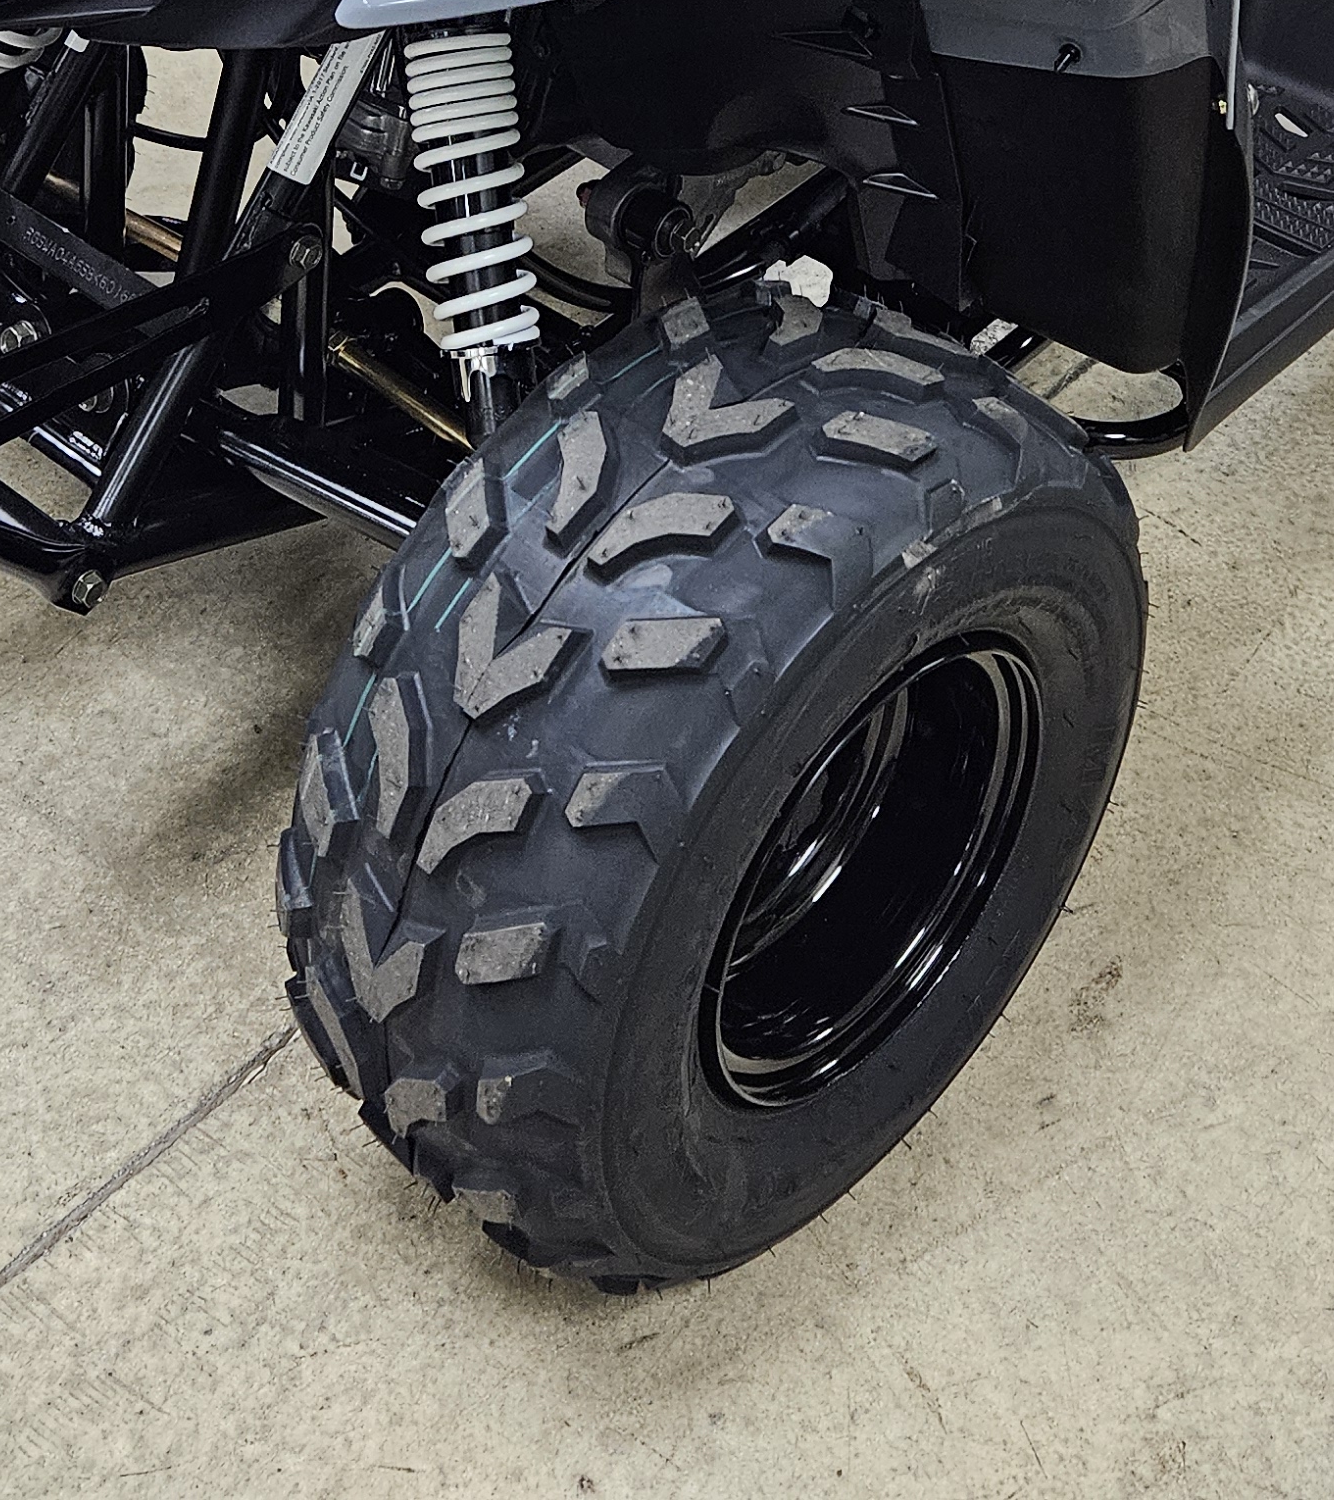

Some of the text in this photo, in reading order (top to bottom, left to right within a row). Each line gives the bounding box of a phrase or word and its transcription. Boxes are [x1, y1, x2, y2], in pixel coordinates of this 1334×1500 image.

[301, 103, 319, 132] Kawasaki
[315, 84, 328, 104] Action
[325, 70, 335, 84] Plan
[337, 49, 346, 60] file
[289, 145, 308, 176] Consumer
[304, 121, 320, 145] Product
[316, 102, 330, 122] Safety
